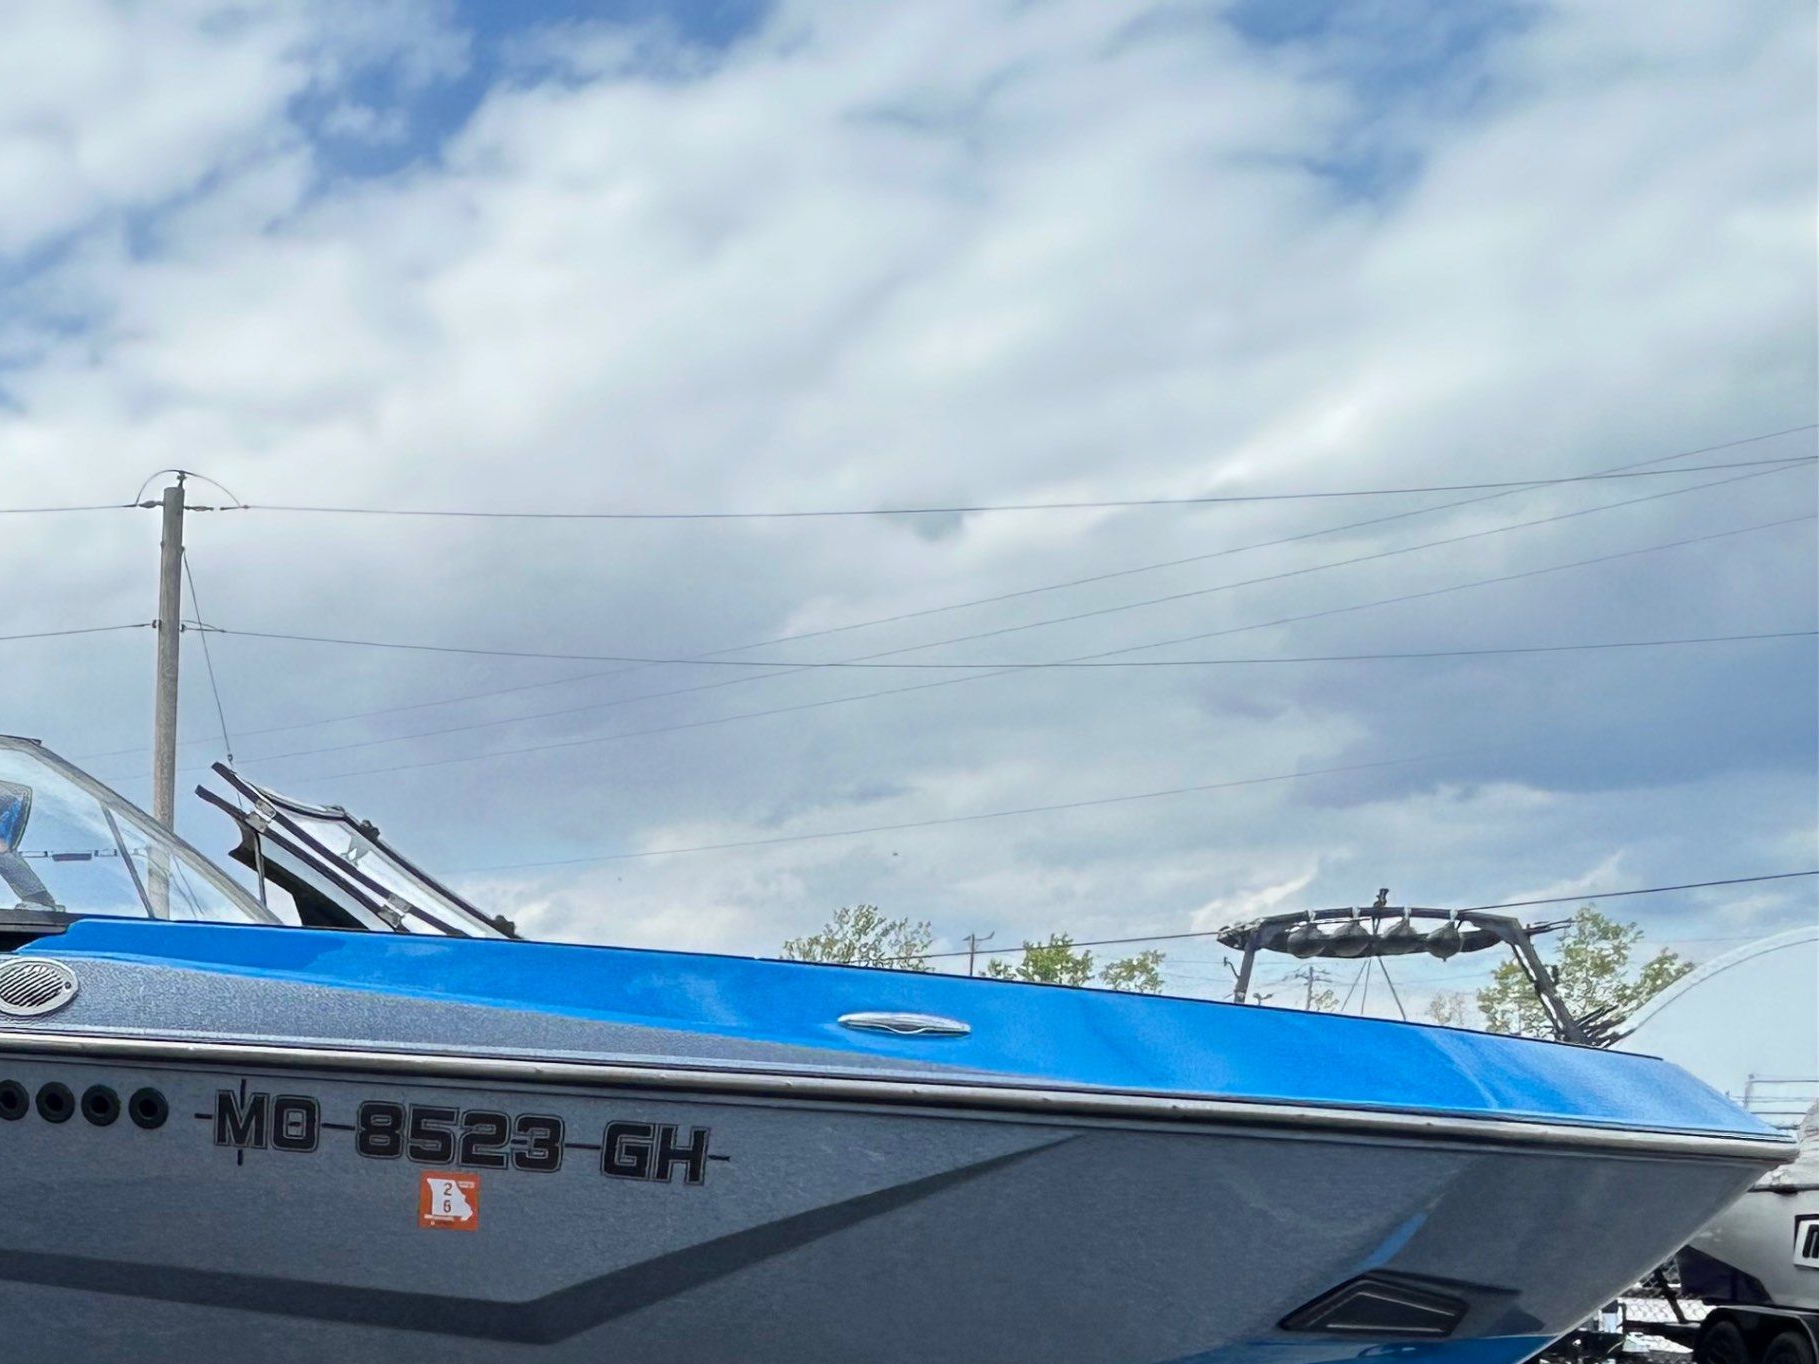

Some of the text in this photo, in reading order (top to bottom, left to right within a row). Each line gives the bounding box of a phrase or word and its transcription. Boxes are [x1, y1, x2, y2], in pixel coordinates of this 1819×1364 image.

[215, 1090, 709, 1185] MO 8523 GH
[443, 1183, 453, 1196] 2
